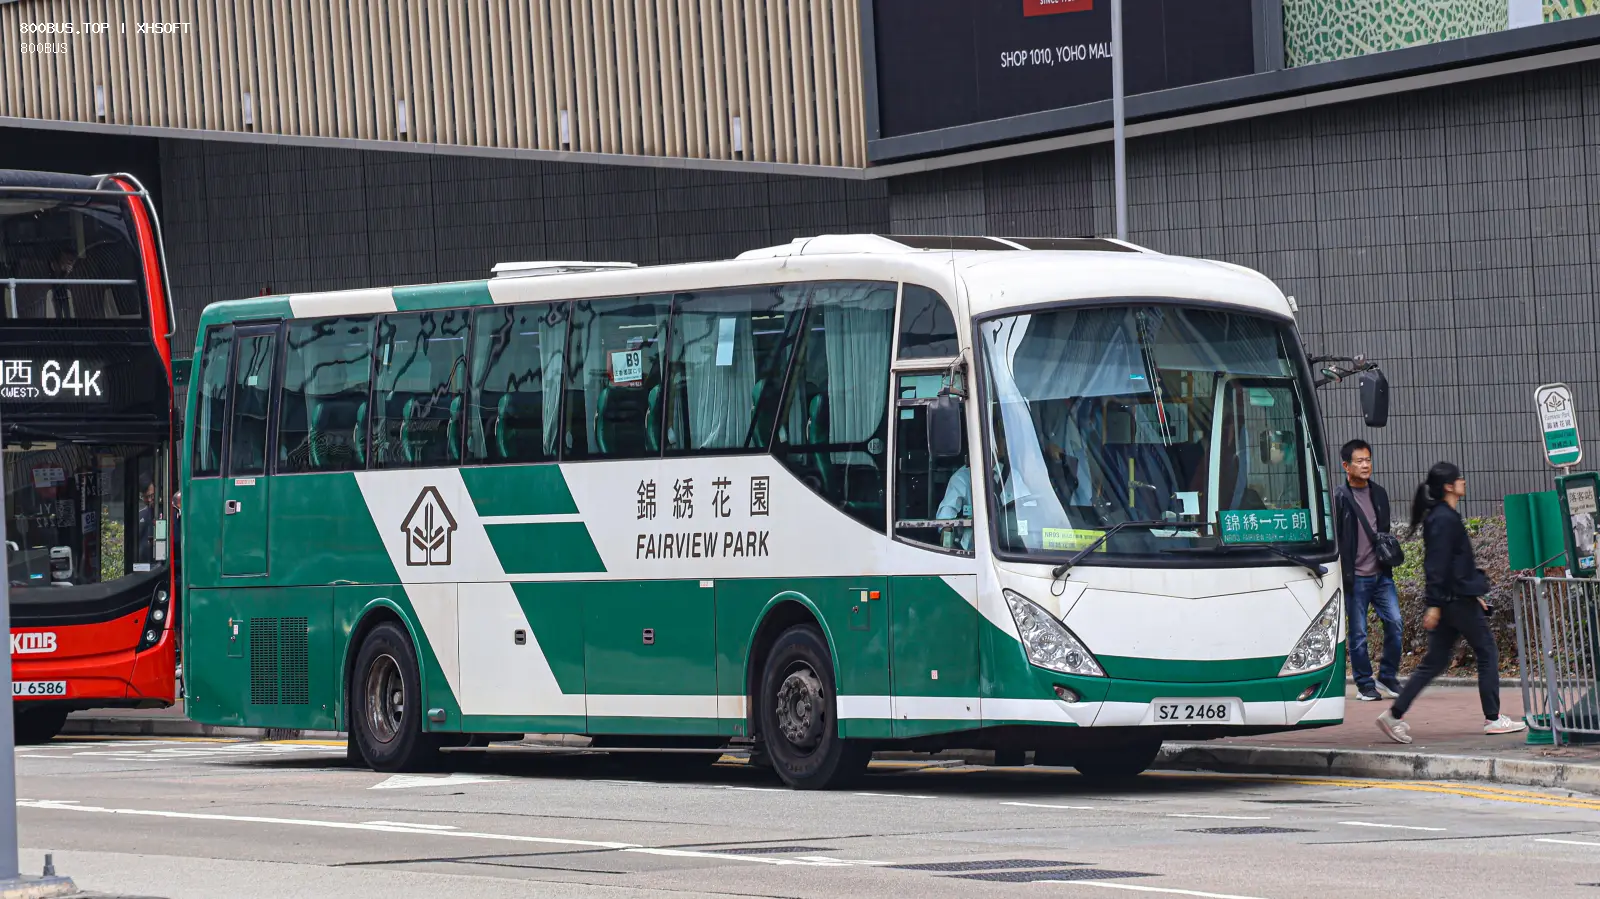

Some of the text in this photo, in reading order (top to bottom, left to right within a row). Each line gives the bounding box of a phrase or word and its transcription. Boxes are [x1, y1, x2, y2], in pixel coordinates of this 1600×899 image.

[1001, 50, 1028, 68] SHOP
[1029, 47, 1054, 66] 1010,
[1055, 44, 1087, 62] YOHO
[626, 352, 640, 367] B9
[0, 360, 32, 386] 西
[42, 360, 101, 396] 64K
[0, 387, 39, 397] (WEST)
[636, 476, 770, 520] 錦綉花園
[636, 530, 769, 559] FAIRVIEW PARK
[28, 682, 63, 694] 6586
[1159, 705, 1226, 719] SZ 2468
